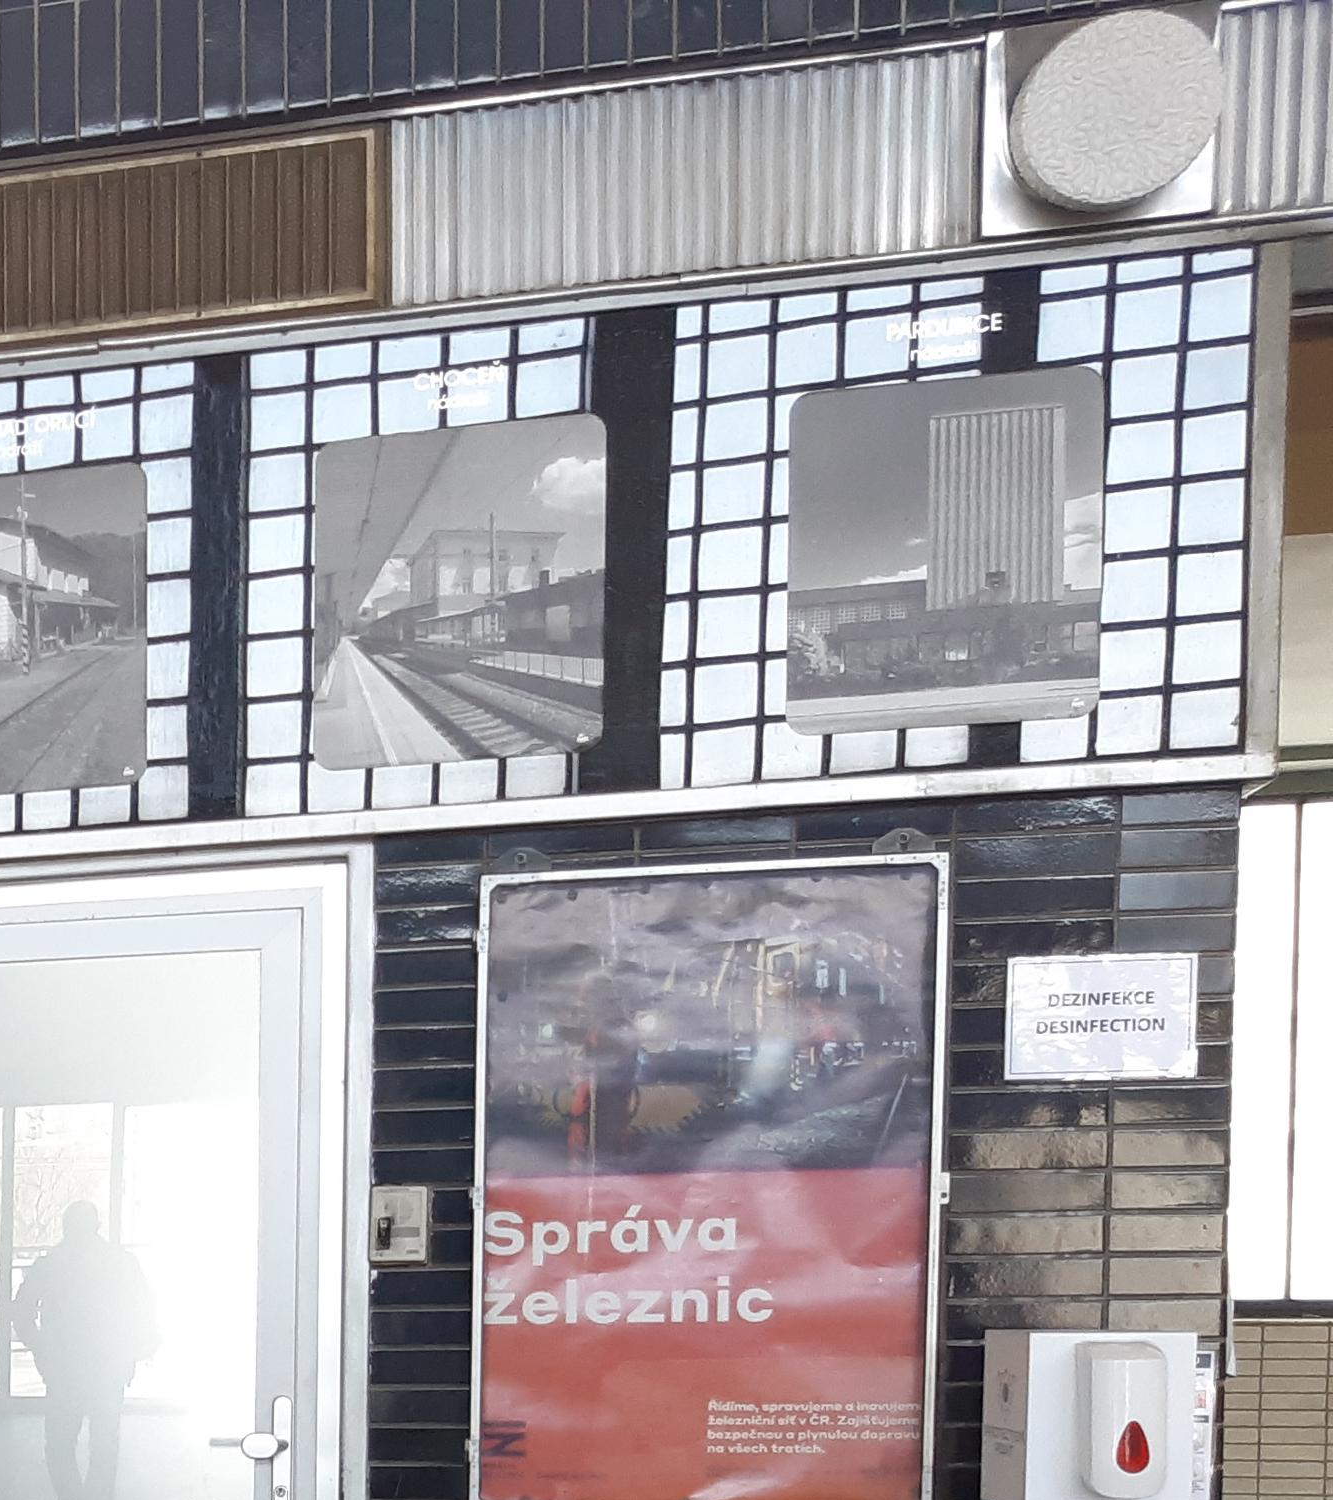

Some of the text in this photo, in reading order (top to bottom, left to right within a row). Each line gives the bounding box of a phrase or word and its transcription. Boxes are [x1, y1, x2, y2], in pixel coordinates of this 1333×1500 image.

[886, 313, 1003, 342] PARDUBICE
[1048, 990, 1156, 1008] DEZINFEKCE
[1035, 1017, 1166, 1035] DESINFECTION
[484, 1204, 737, 1268] Správa
[483, 1275, 774, 1325] železnic
[707, 1400, 921, 1414] Řídíme, spravujeme a inovujem
[707, 1414, 776, 1426] železniční
[777, 1414, 797, 1426] síť
[799, 1417, 807, 1426] v
[809, 1414, 835, 1426] ČR.
[707, 1429, 921, 1442] bezpečnou a plynulou dopravu
[706, 1442, 827, 1454] na všech tratích.
